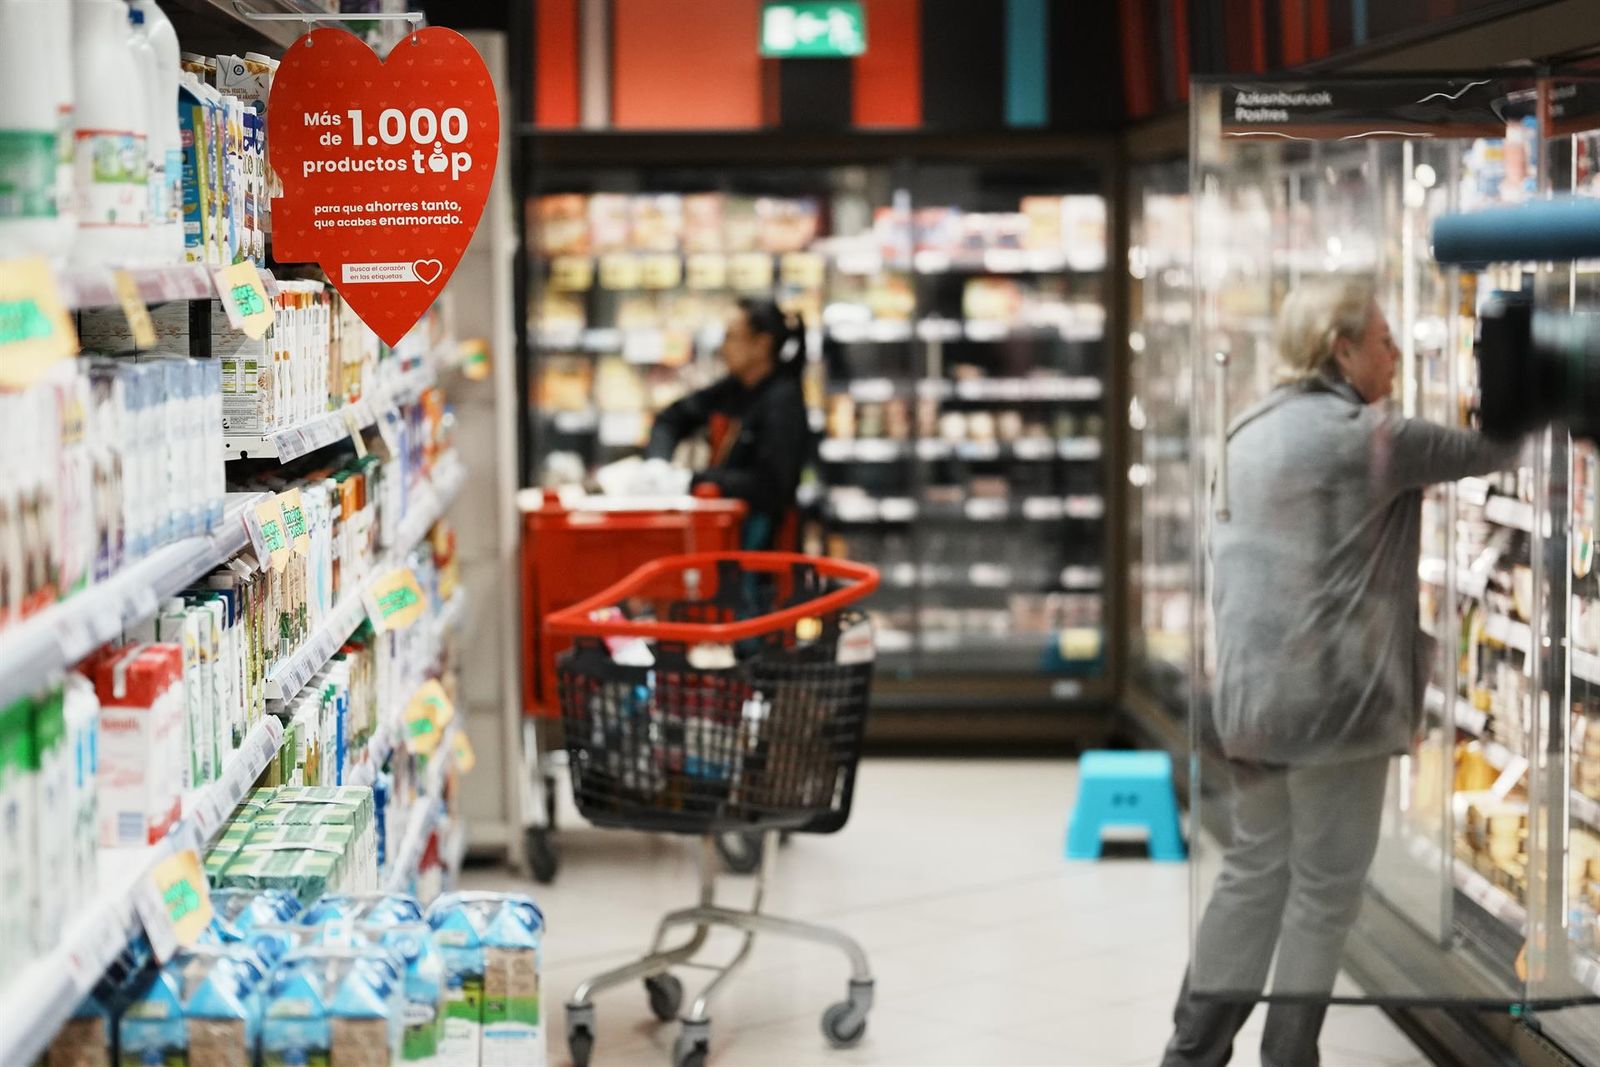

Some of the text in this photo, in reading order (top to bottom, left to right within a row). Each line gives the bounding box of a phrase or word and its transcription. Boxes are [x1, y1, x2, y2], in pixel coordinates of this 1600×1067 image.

[1235, 107, 1290, 122] Postres
[304, 108, 469, 146] Más 1.000
[319, 131, 342, 146] de
[303, 142, 473, 180] productos top
[314, 200, 462, 216] para que ahorres tanto,
[313, 213, 463, 230] que acabes enamorado.
[371, 272, 403, 280] etiquetas
